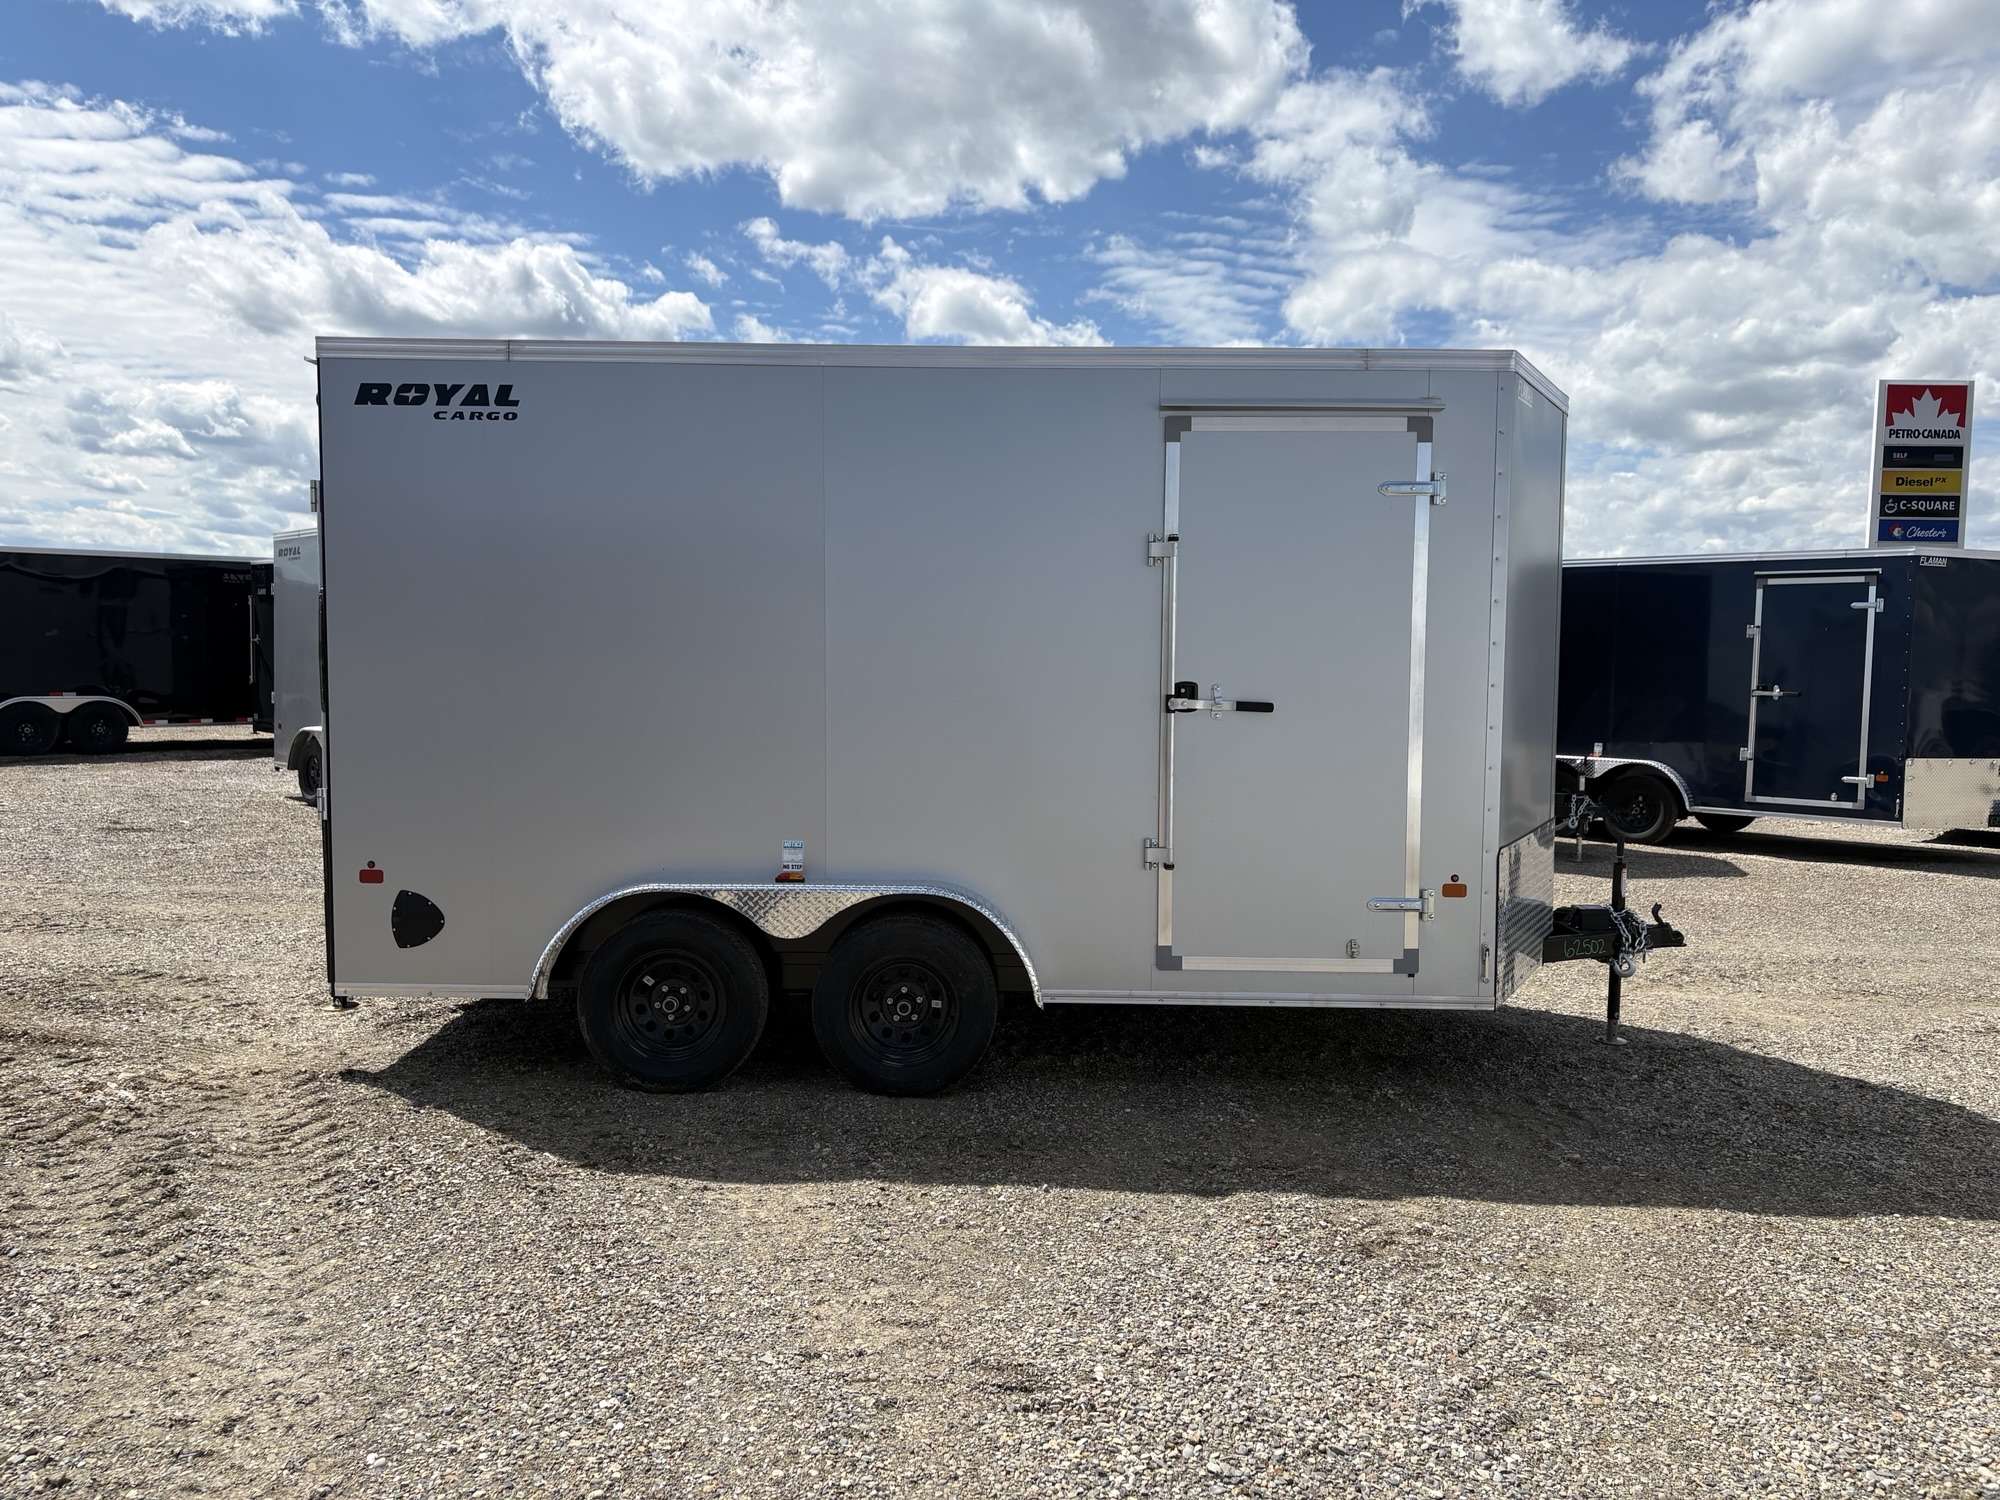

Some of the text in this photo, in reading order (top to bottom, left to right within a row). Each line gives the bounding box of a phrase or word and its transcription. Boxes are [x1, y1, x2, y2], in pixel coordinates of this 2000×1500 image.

[354, 382, 520, 407] ROYAL
[433, 410, 518, 421] CARGO
[1895, 476, 1933, 487] Diesel
[1900, 500, 1956, 512] C-SQUARE
[1906, 526, 1947, 538] Chester's
[278, 545, 301, 558] ROYAL
[1920, 556, 1948, 567] FLAMAN
